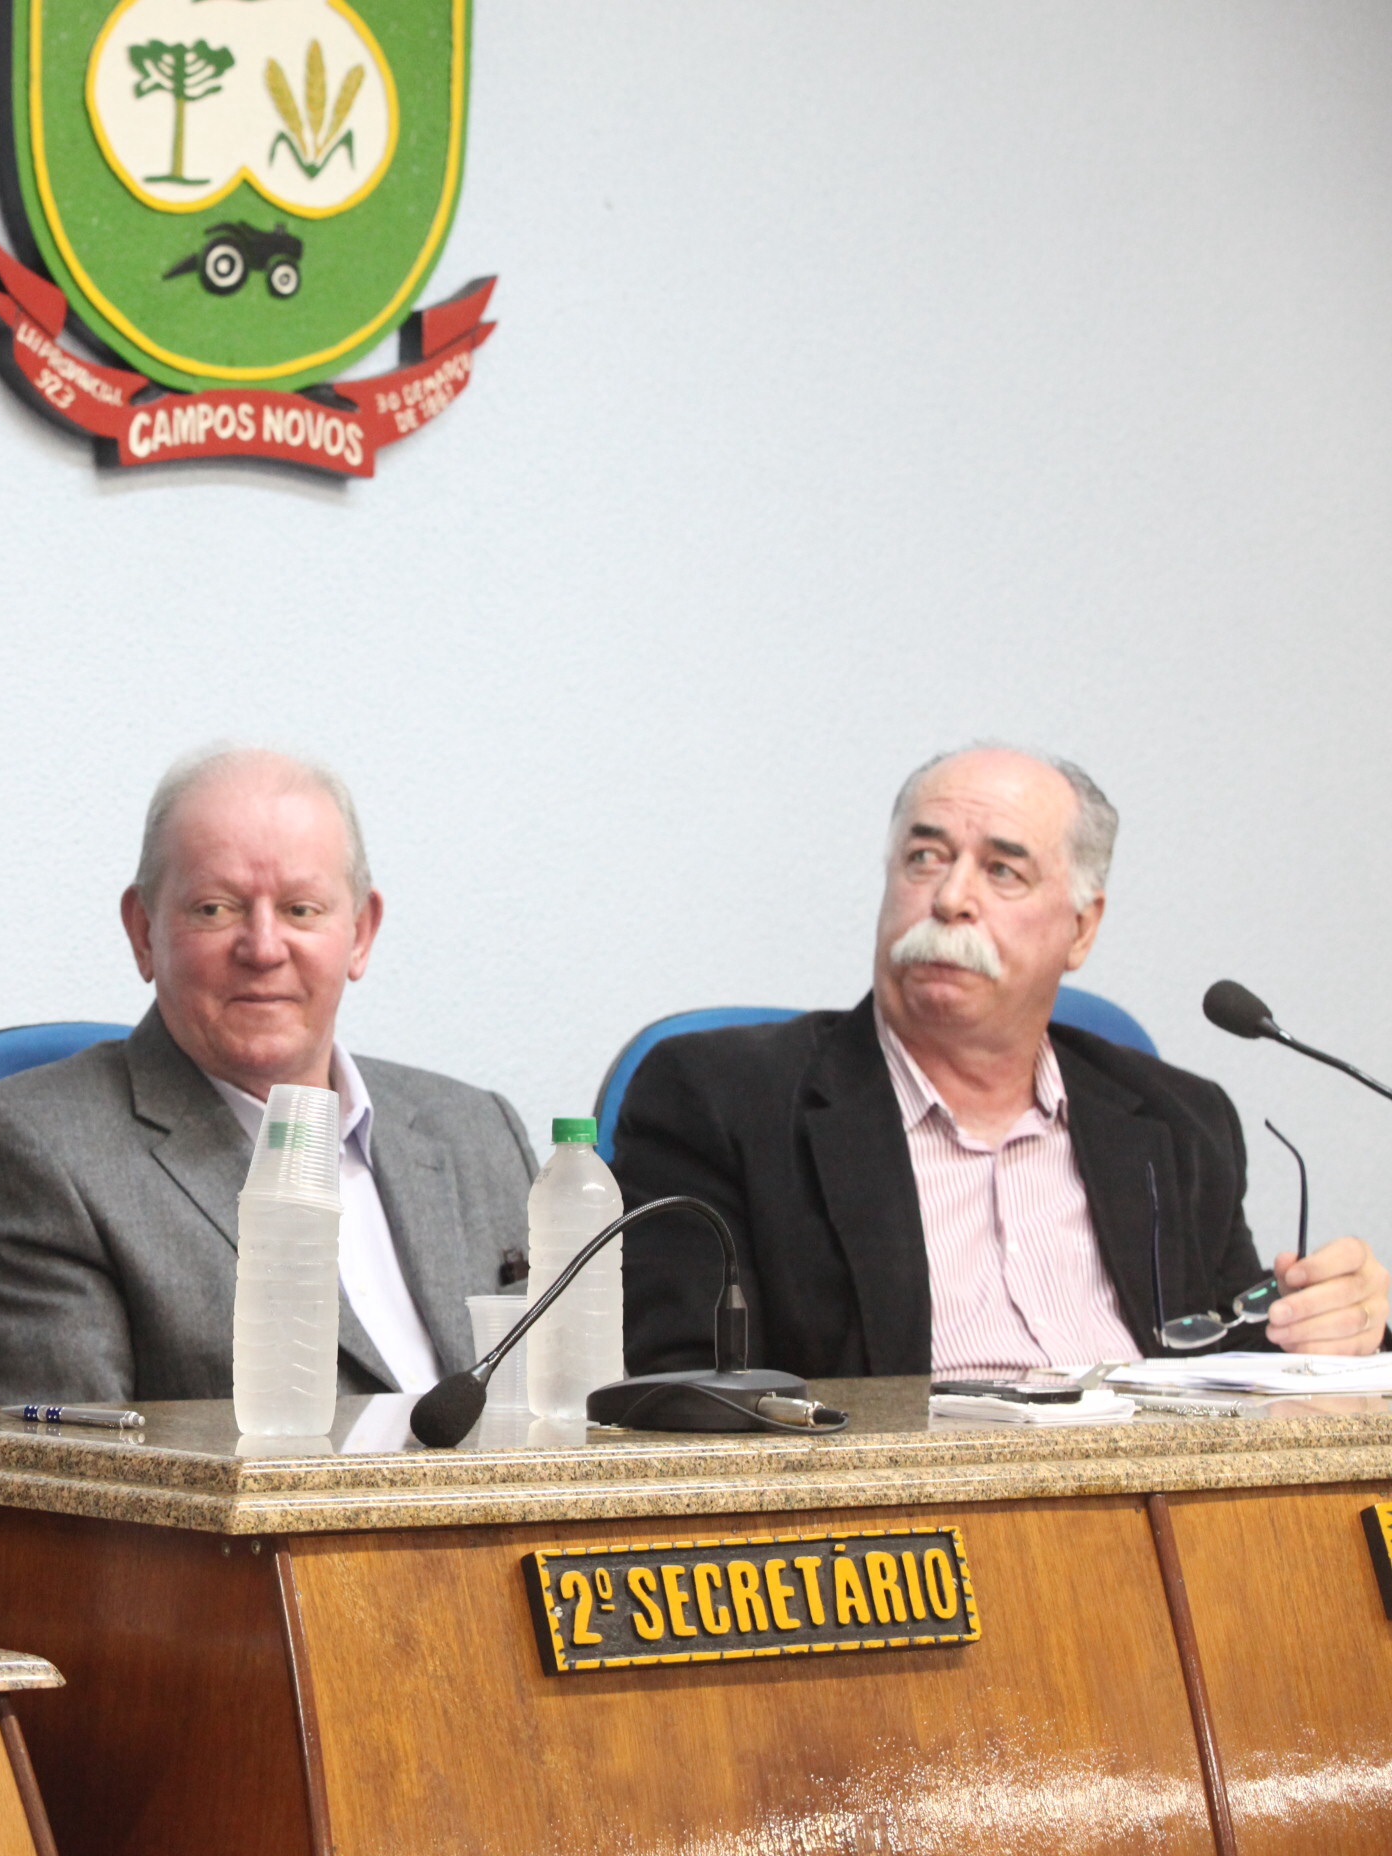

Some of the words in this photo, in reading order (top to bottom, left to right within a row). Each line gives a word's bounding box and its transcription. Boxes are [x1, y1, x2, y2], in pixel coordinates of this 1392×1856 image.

[128, 403, 256, 458] CAMPOS
[262, 405, 364, 466] NOVOS
[626, 1543, 958, 1640] SECRETÁRIO
